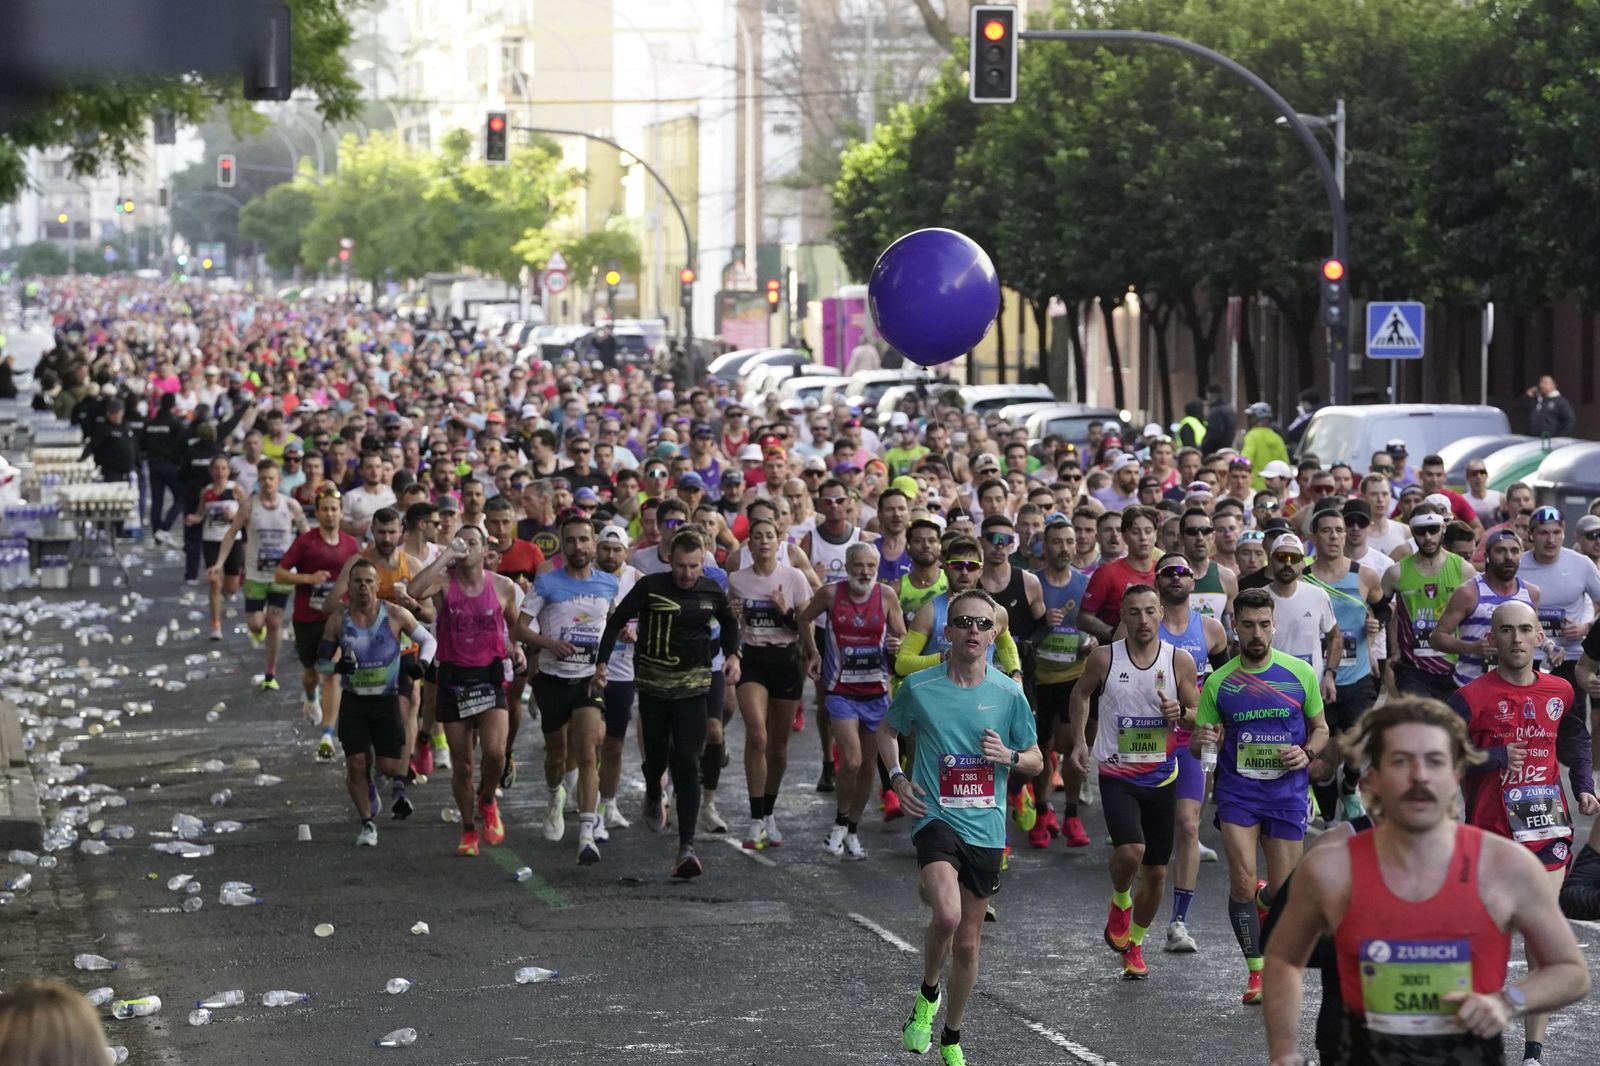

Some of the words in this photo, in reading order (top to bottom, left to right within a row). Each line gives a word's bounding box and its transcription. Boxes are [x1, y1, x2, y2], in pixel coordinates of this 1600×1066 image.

[750, 618, 775, 626] CLARA
[1130, 742, 1157, 751] JUANI
[1256, 748, 1273, 756] 3070
[1244, 757, 1285, 768] ANDRES
[960, 773, 978, 781] 1383
[953, 783, 984, 795] MARK
[1526, 788, 1555, 797] ZURICH
[1529, 804, 1548, 813] 4845
[1526, 814, 1556, 828] FEDE
[1397, 945, 1459, 960] ZURICH
[1394, 992, 1440, 1011] SAM
